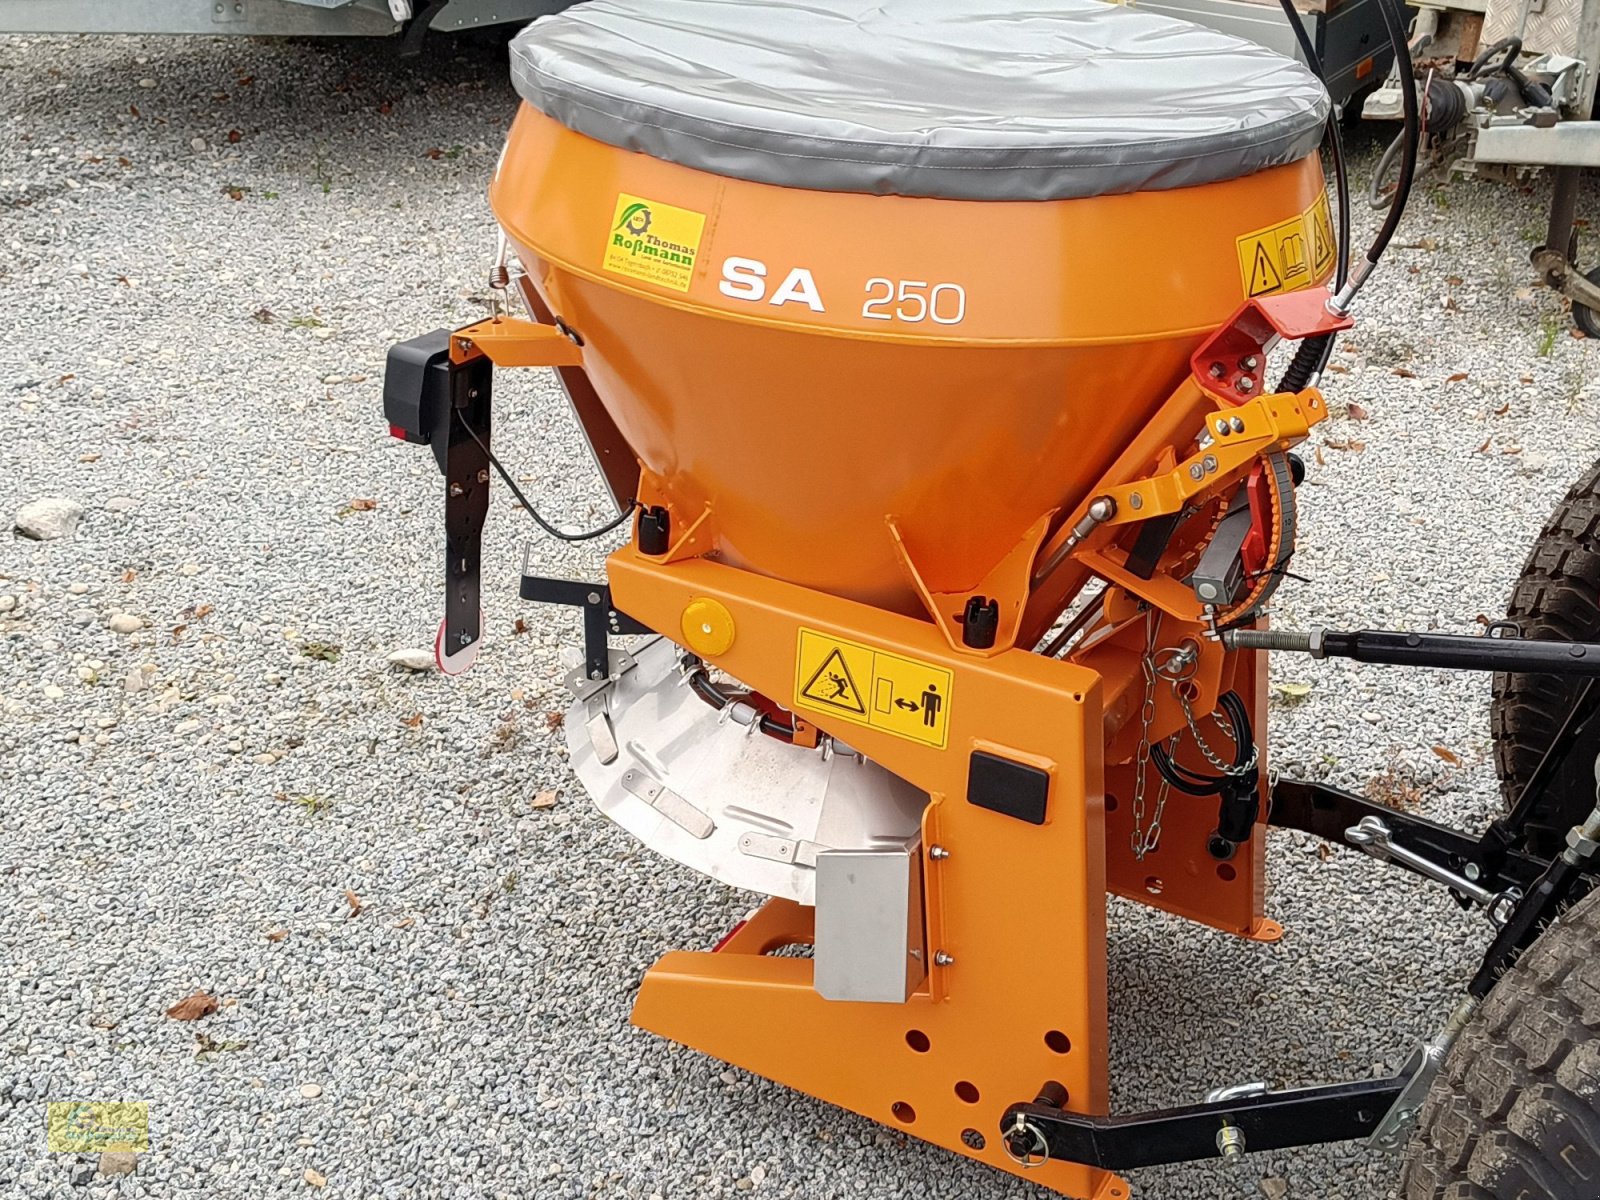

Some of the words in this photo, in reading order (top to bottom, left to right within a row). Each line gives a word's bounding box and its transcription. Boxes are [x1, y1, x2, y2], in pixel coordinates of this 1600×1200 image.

[612, 233, 693, 266] Roßmann
[646, 234, 696, 256] Thomas
[718, 255, 826, 313] SA
[862, 276, 967, 325] 250
